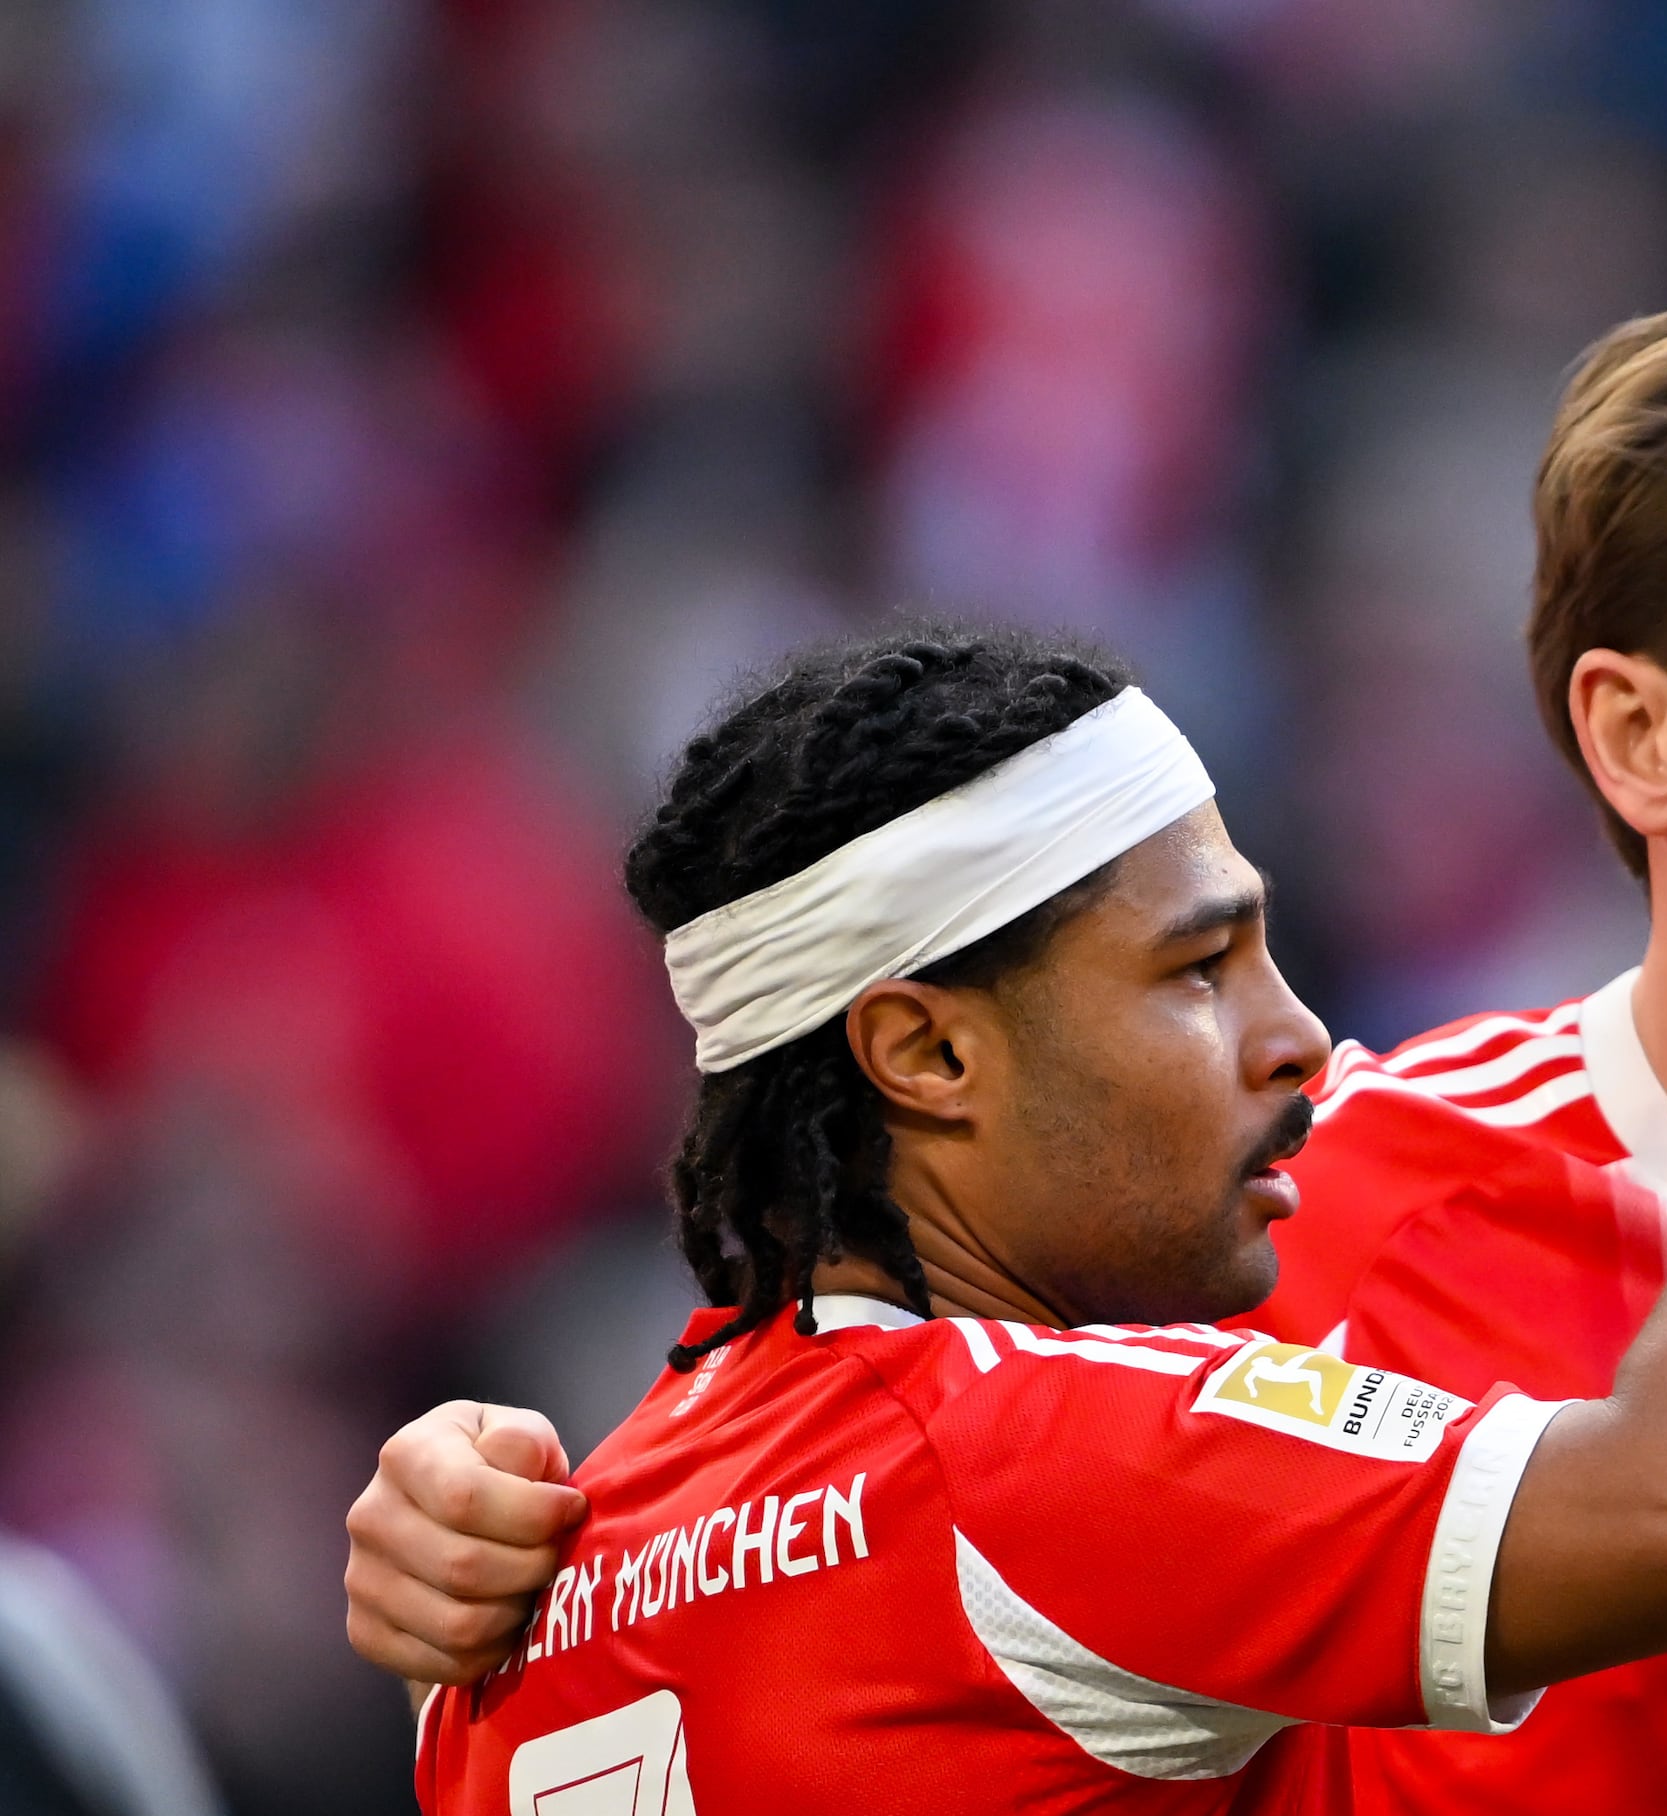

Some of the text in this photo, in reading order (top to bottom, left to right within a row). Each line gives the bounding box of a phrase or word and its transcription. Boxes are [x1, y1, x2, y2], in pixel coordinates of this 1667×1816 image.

[1342, 1367, 1393, 1436] BUND
[1400, 1385, 1425, 1419] DEU
[1403, 1392, 1445, 1448] FUSSBA
[610, 1471, 870, 1632] MÜNCHEN
